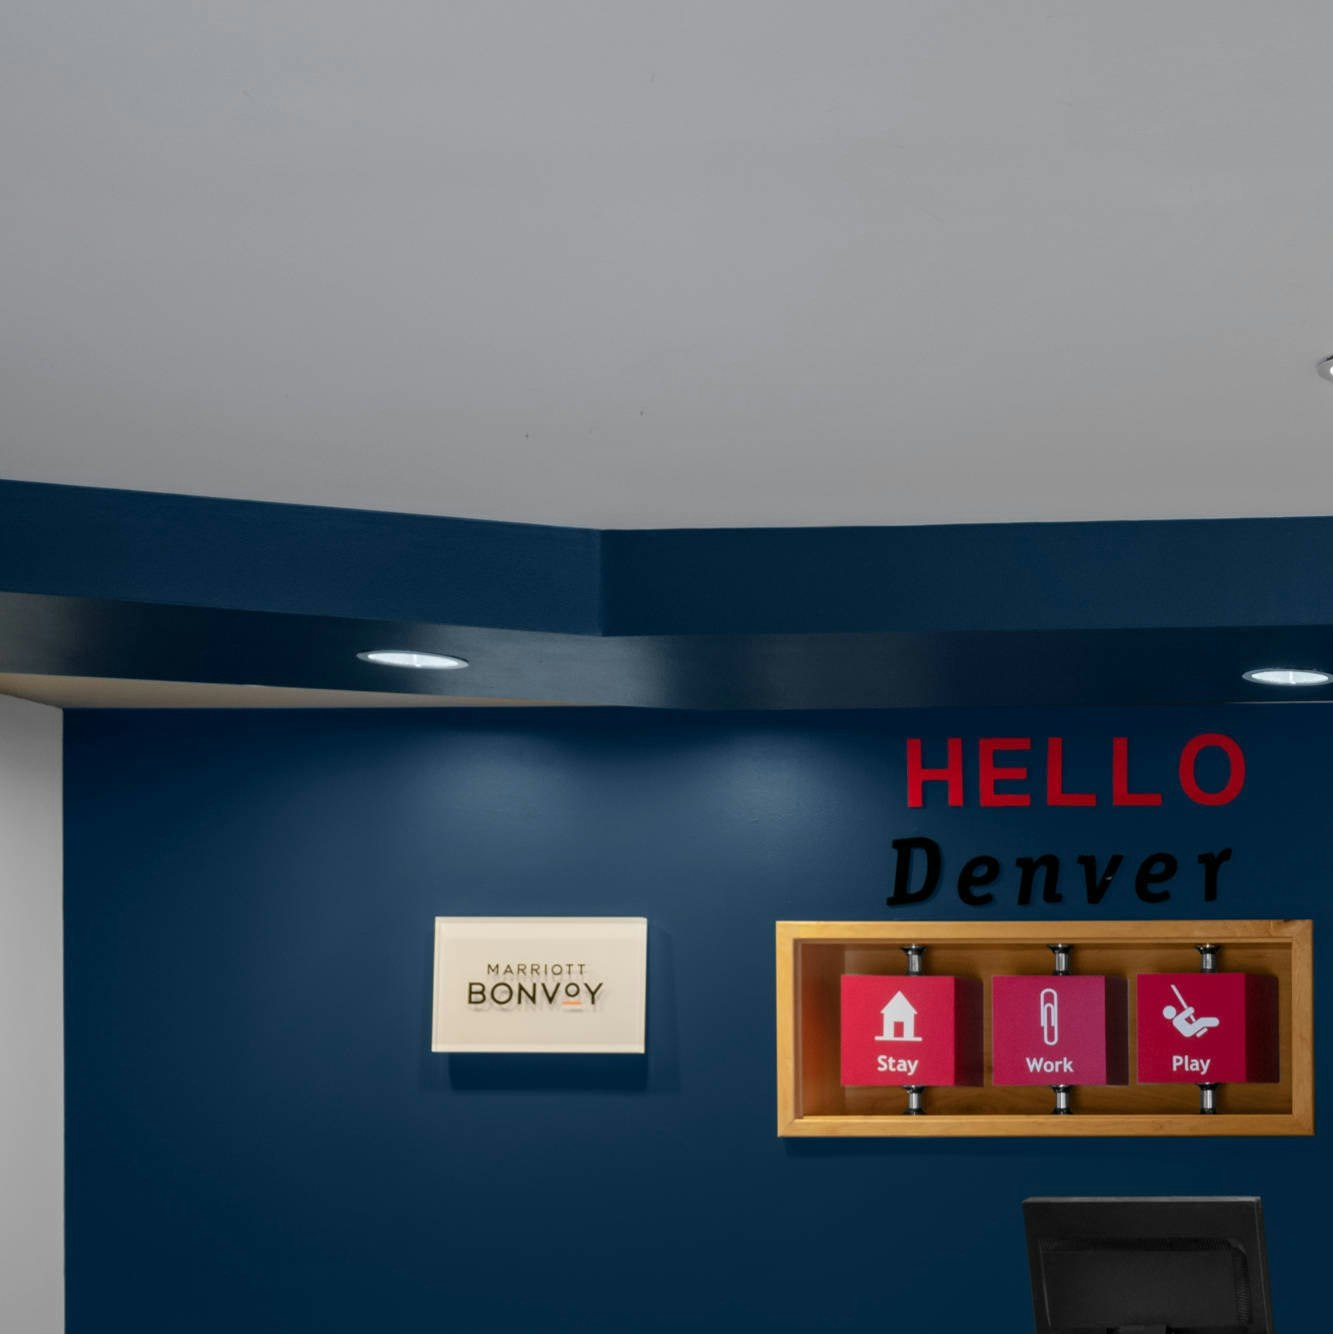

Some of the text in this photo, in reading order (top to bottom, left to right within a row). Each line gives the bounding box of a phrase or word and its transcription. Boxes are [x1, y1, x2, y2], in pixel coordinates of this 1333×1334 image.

[906, 733, 1246, 807] HELLO
[886, 836, 1233, 907] Denver
[487, 963, 586, 977] MARRIOTT
[467, 981, 604, 1006] BONVOY
[876, 1055, 919, 1076] Stay
[1025, 1057, 1074, 1073] Work
[1171, 1055, 1211, 1076] Play
